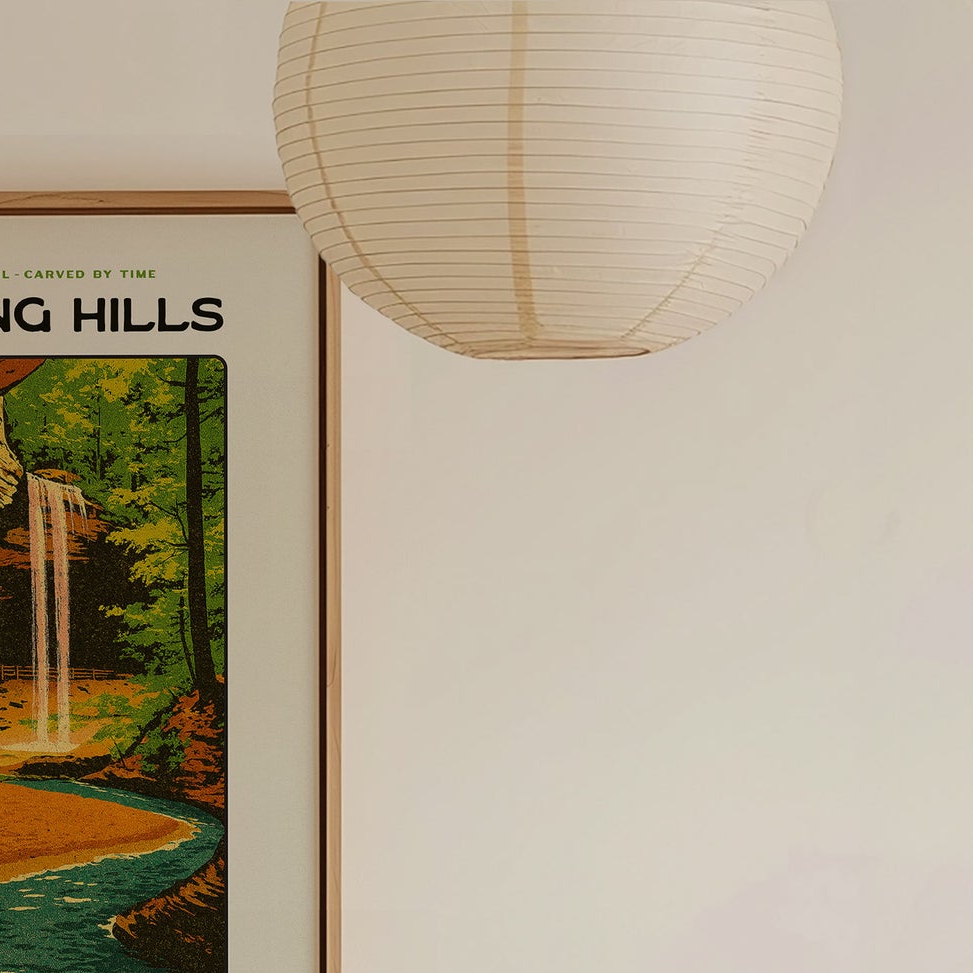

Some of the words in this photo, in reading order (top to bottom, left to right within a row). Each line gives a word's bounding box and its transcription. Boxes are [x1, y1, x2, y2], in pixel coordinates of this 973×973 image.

[23, 270, 85, 280] CARVED
[92, 270, 112, 280] BY
[119, 269, 157, 279] TIME
[73, 297, 224, 333] HILLS
